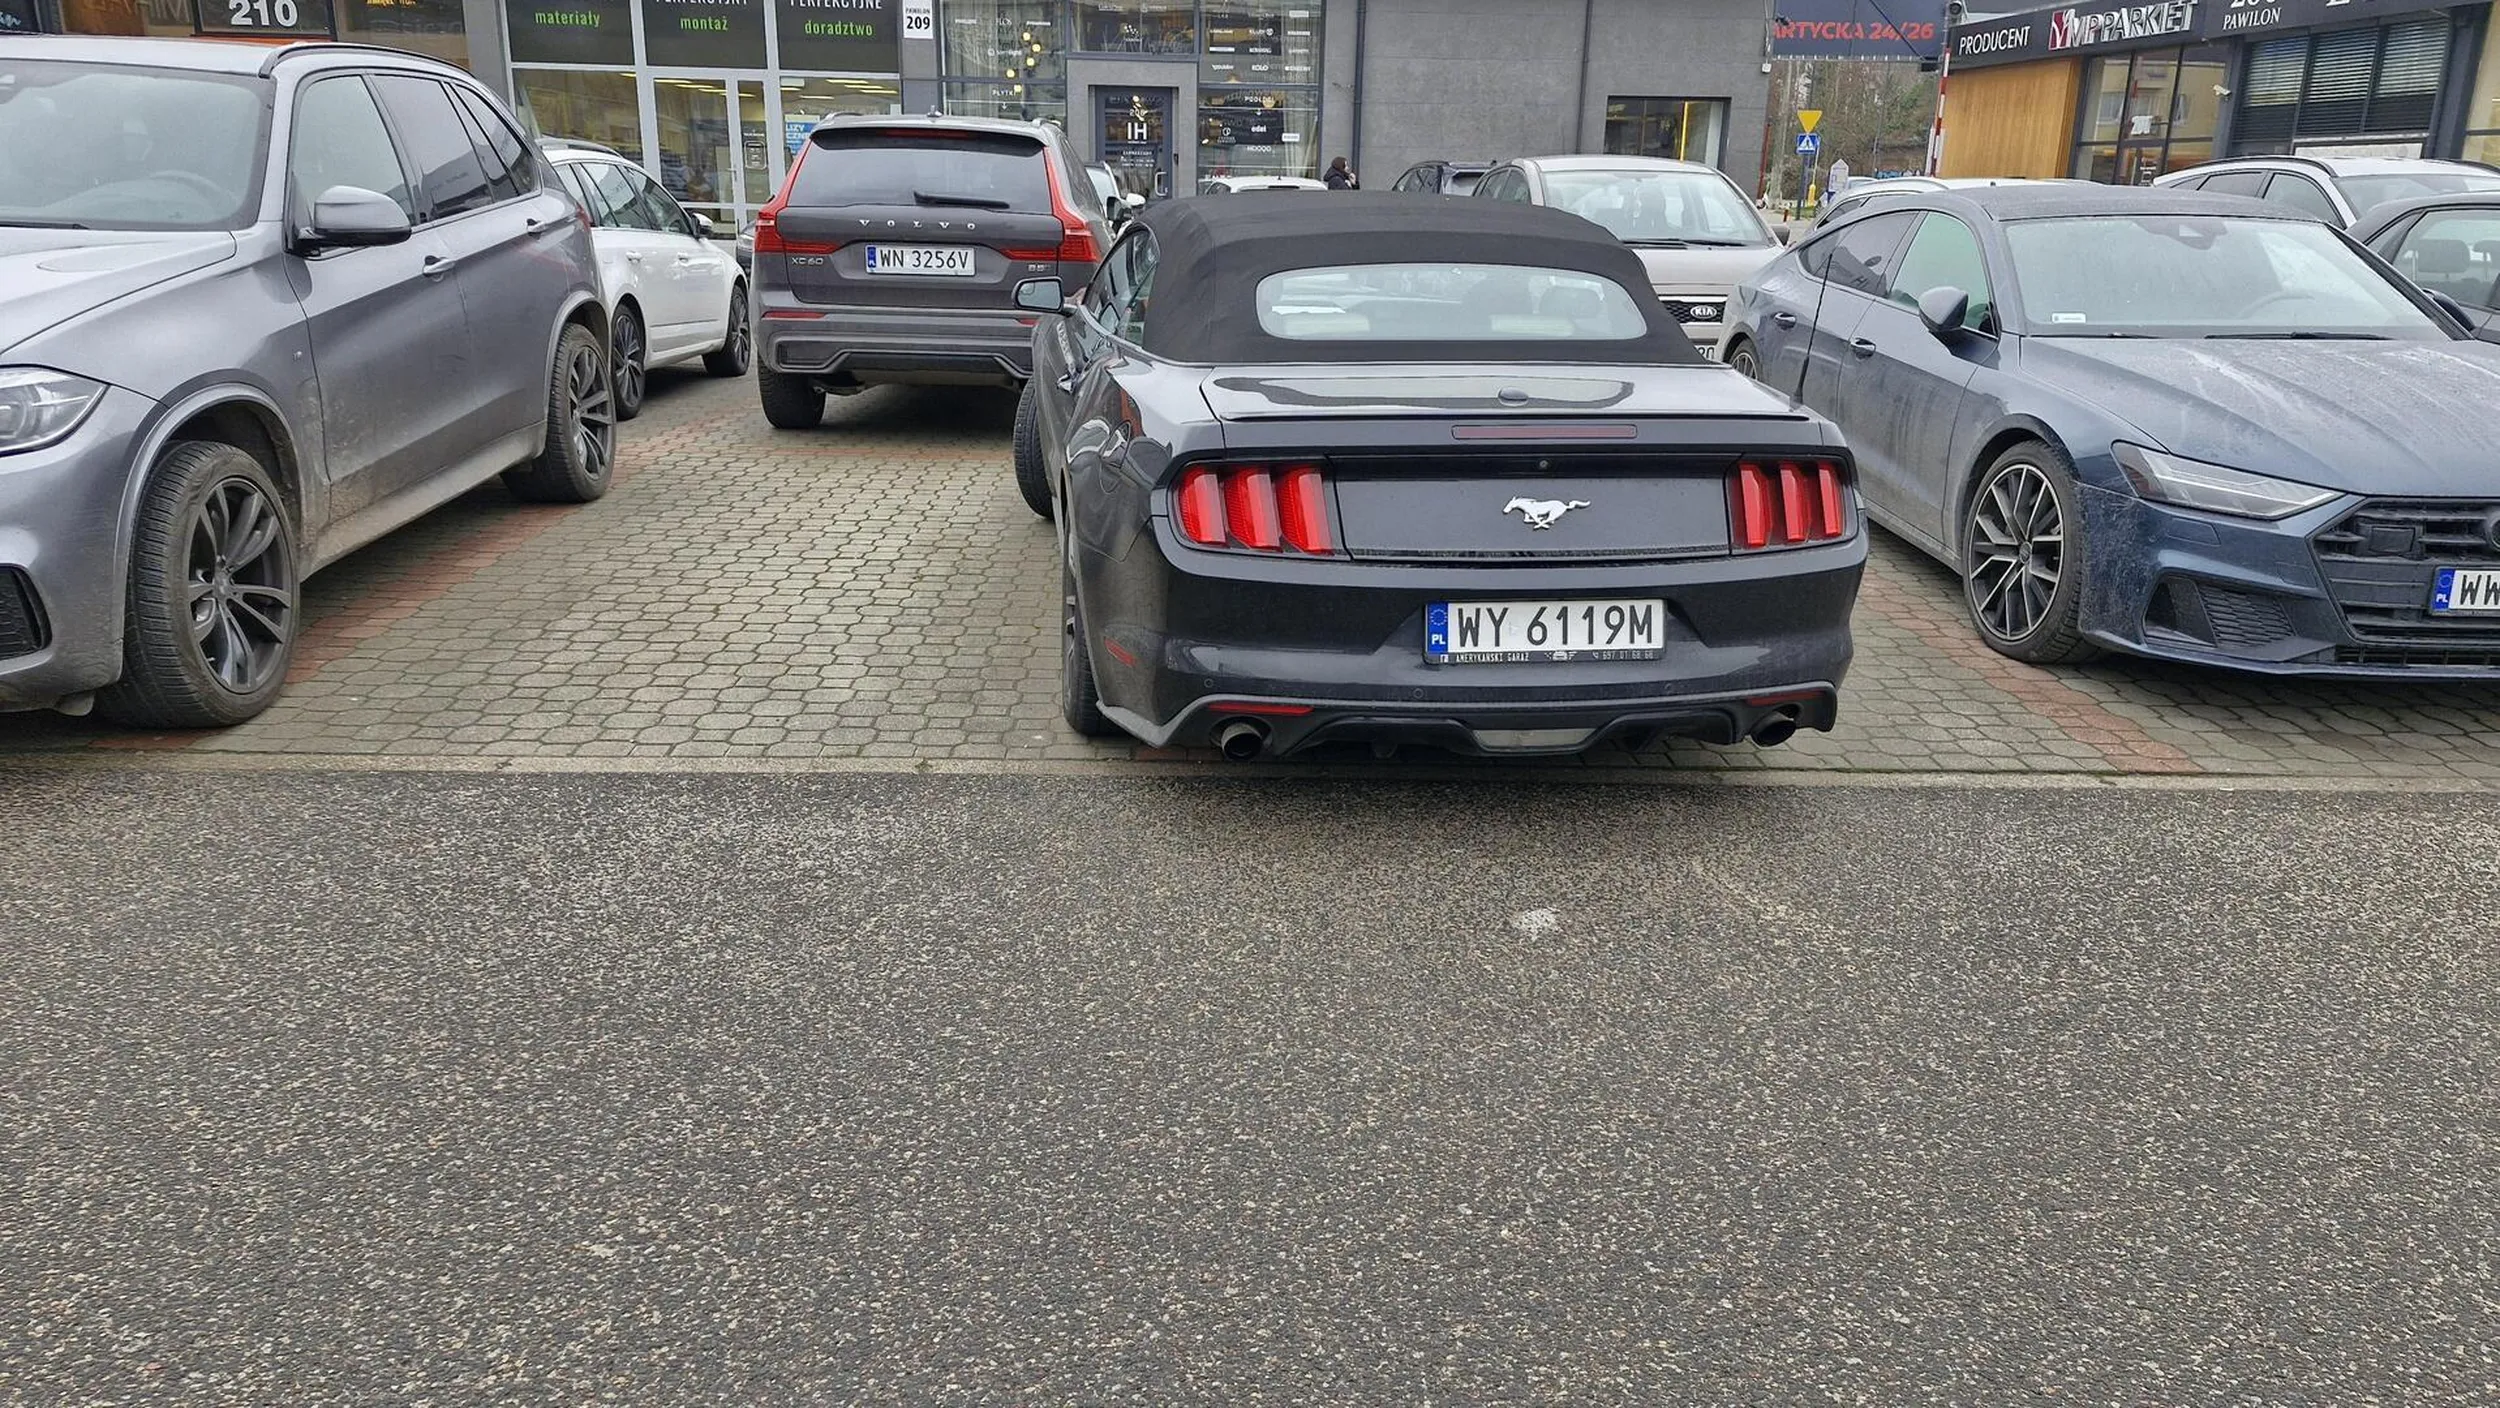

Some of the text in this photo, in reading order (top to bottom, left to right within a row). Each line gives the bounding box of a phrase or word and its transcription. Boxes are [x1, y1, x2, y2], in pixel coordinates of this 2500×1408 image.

[229, 0, 298, 27] 210
[535, 10, 600, 27] materiały
[2222, 7, 2281, 30] PAWILON
[680, 16, 728, 31] montaż
[805, 20, 873, 36] doradztwo
[907, 16, 930, 29] 209
[1869, 22, 1935, 40] 24/26
[1960, 26, 2030, 55] PRODUCENT
[1128, 122, 1147, 140] IH
[859, 218, 975, 230] VOLVO
[792, 257, 824, 265] XC60
[880, 249, 969, 269] WN 3256V
[1695, 307, 1713, 316] KIA
[2436, 593, 2448, 603] PL
[1457, 604, 1652, 648] WY 6119M
[1431, 634, 1446, 645] PL
